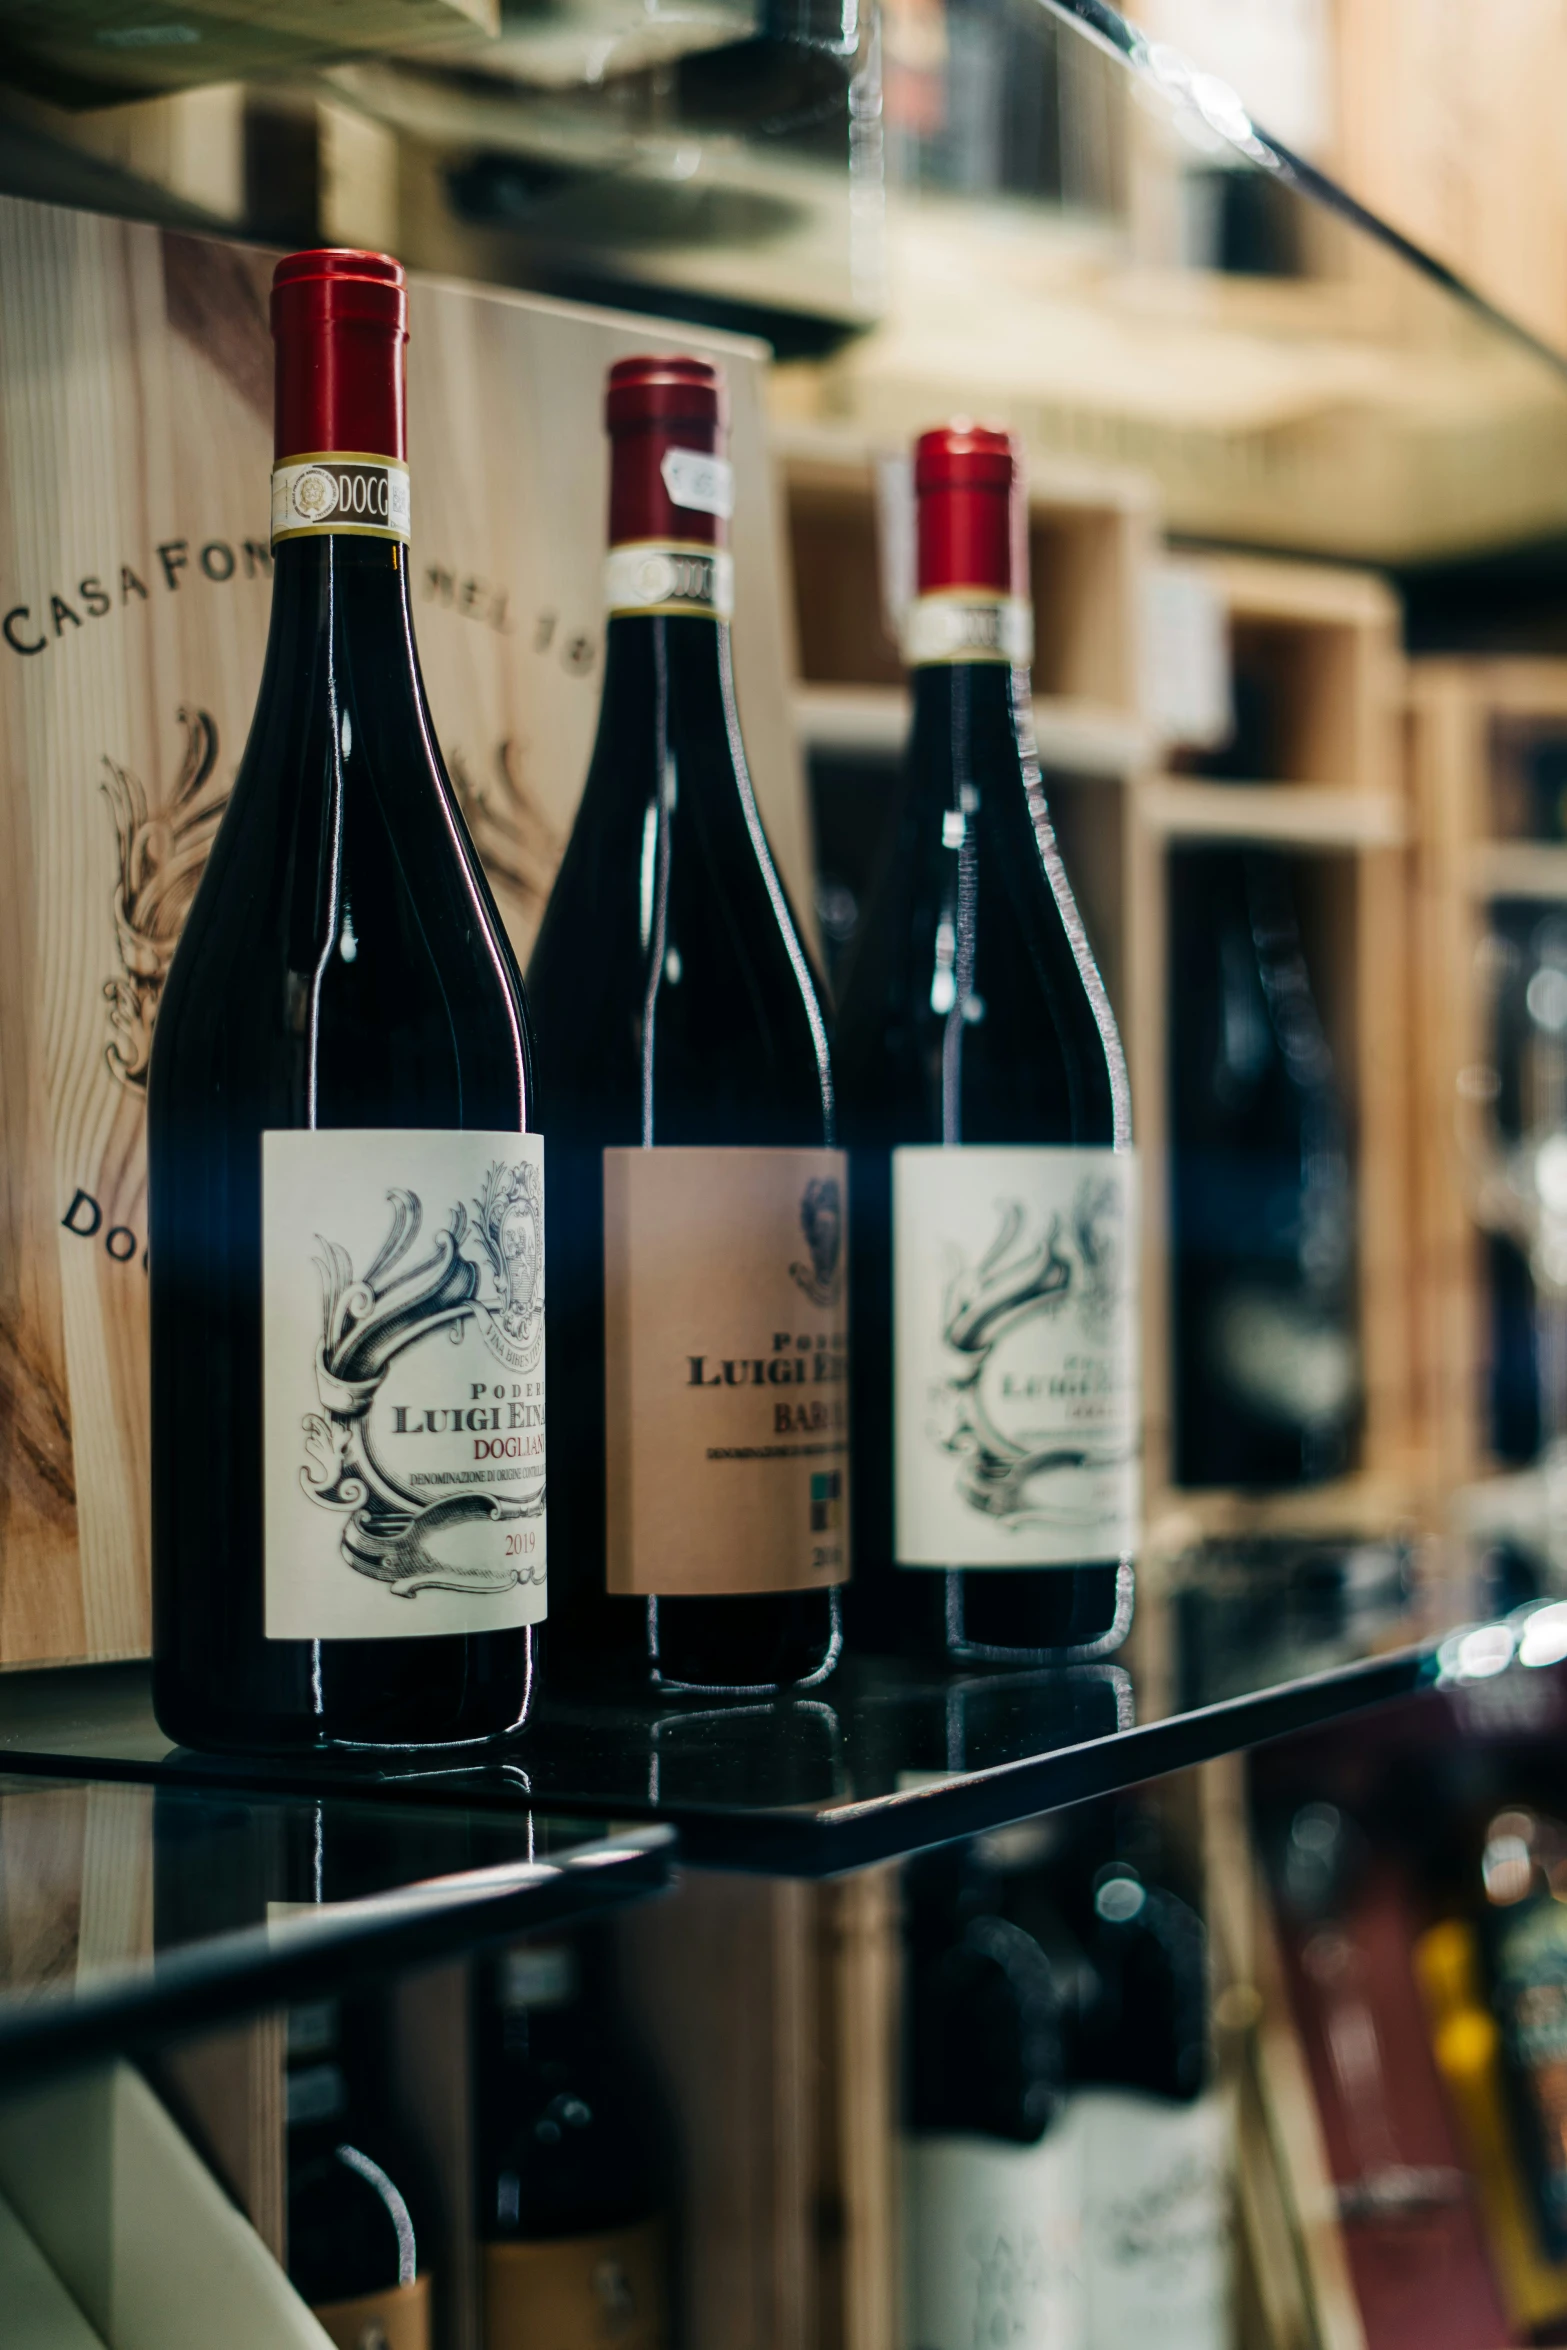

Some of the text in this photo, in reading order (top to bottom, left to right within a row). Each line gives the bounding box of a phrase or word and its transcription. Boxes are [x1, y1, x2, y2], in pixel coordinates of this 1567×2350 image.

[2, 561, 149, 656] CASA
[61, 1187, 149, 1278] DO
[688, 1356, 805, 1386] LUIGI
[391, 1405, 502, 1434] LUIGI
[409, 1470, 486, 1486] DENOMINAZIONE
[505, 1532, 535, 1556] 2019
